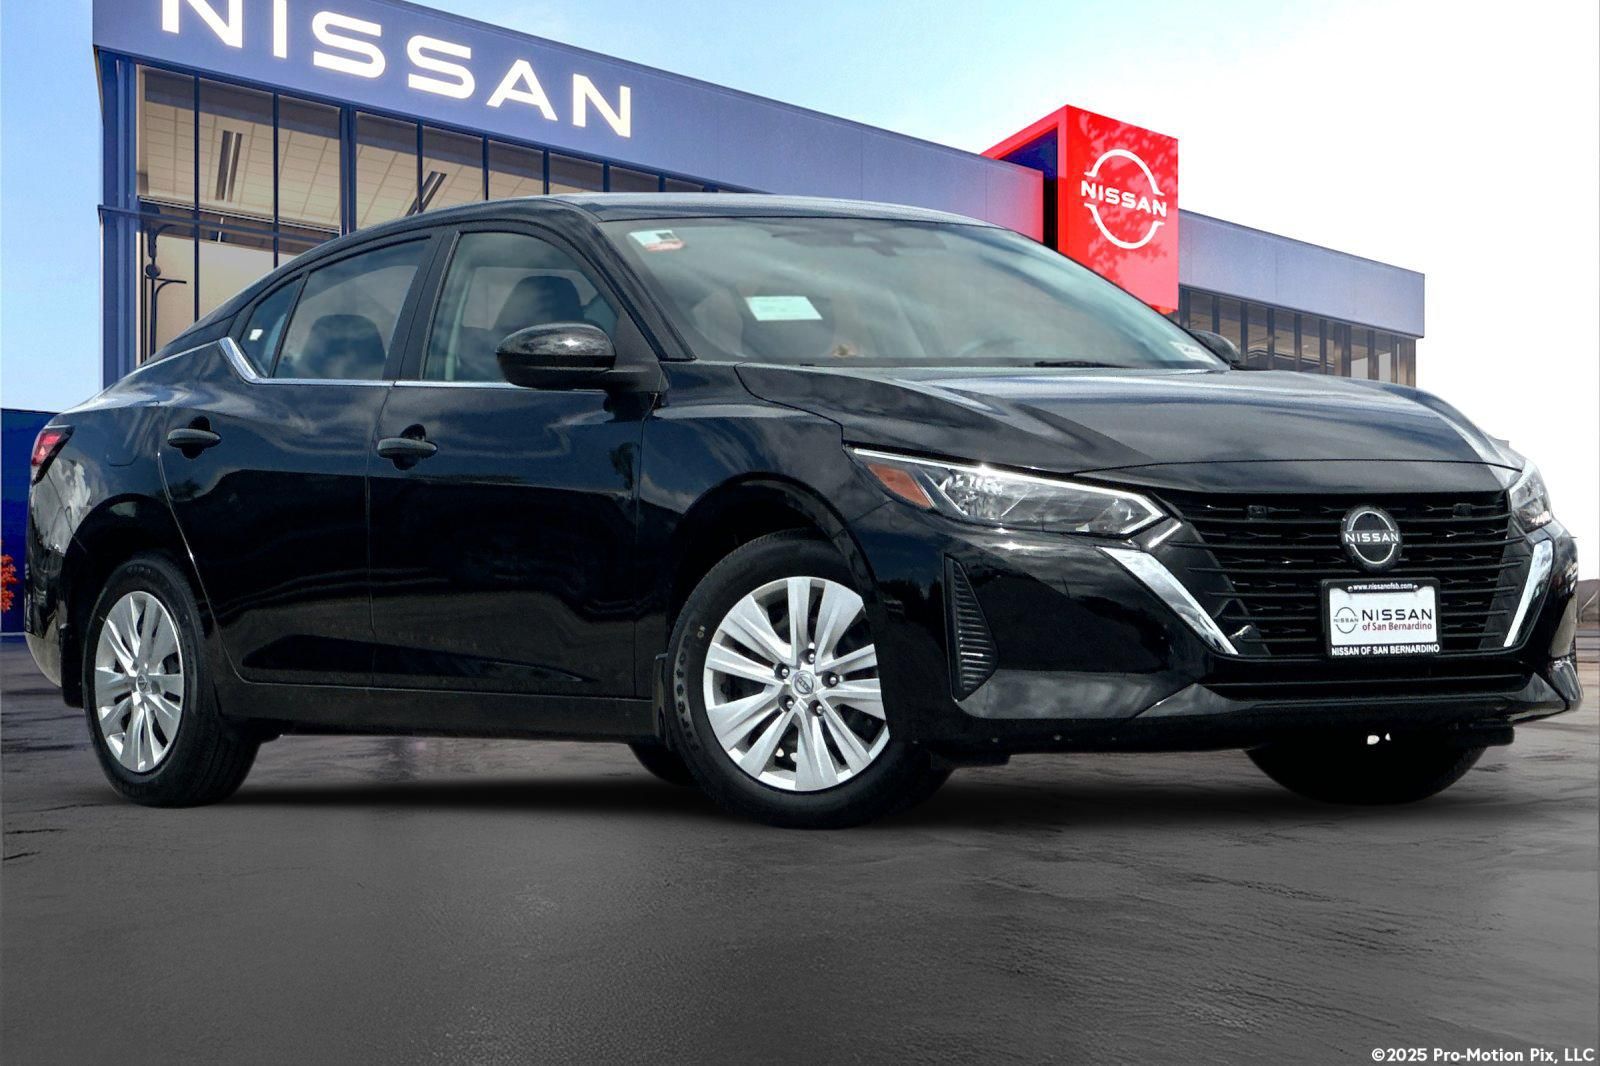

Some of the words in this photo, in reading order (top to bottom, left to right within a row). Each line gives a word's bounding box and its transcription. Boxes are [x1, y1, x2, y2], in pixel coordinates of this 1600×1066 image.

[161, 0, 632, 138] NISSAN
[1081, 181, 1167, 217] NISSAN
[1345, 532, 1399, 543] NISSAN
[1362, 609, 1432, 621] NISSAN
[1362, 622, 1371, 631] of
[1373, 622, 1387, 631] San
[1389, 621, 1432, 630] Bernardino
[1331, 646, 1360, 656] NISSAN
[1360, 645, 1371, 655] OF
[1372, 645, 1389, 655] SAN
[1389, 644, 1440, 654] BERNARDINO
